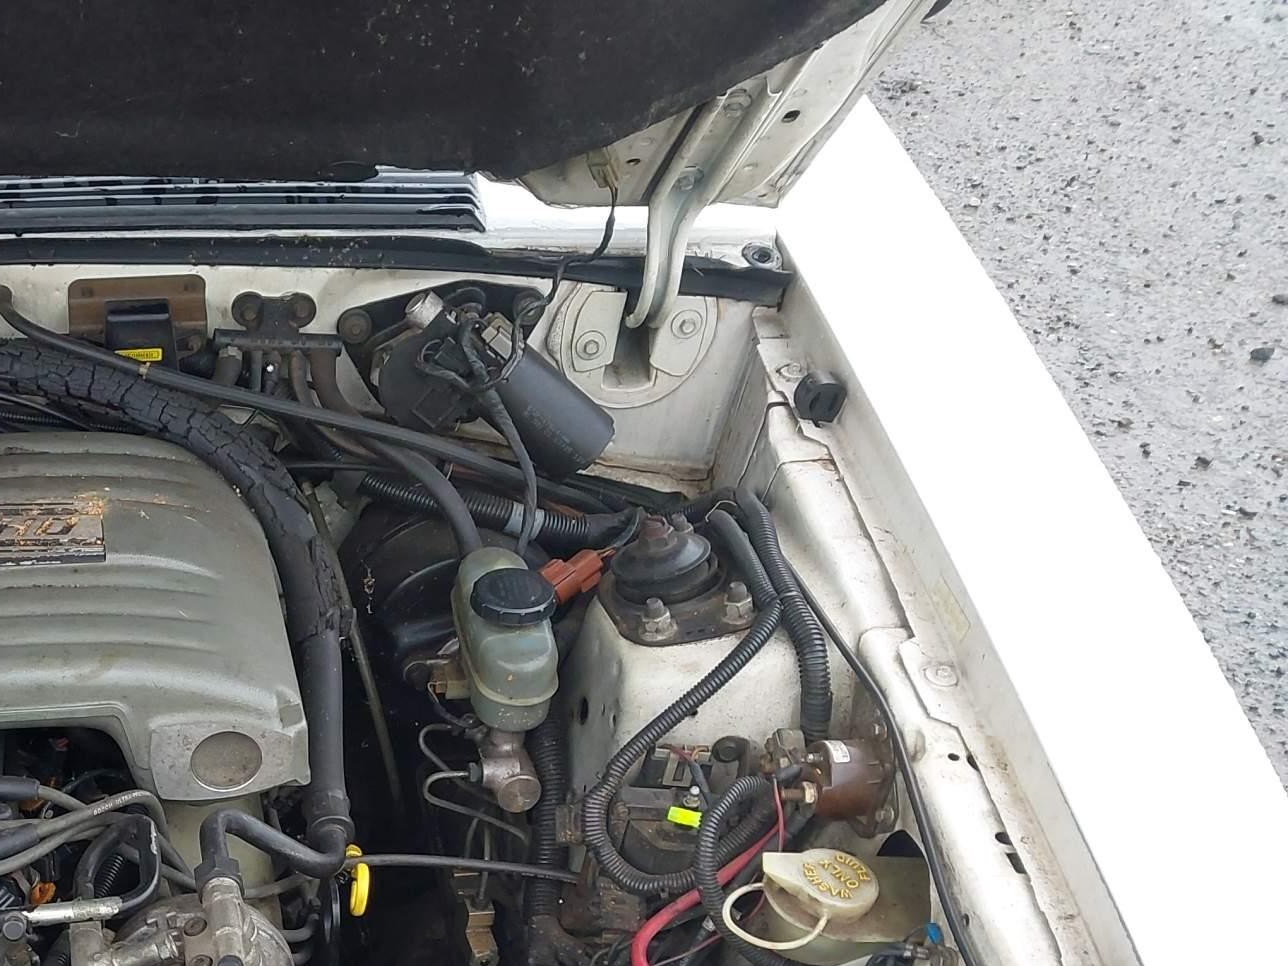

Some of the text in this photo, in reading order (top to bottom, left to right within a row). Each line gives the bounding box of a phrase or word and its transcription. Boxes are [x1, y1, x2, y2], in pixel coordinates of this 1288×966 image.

[803, 863, 854, 898] WASHER
[819, 859, 859, 888] ONLY
[835, 854, 871, 881] FLUID
